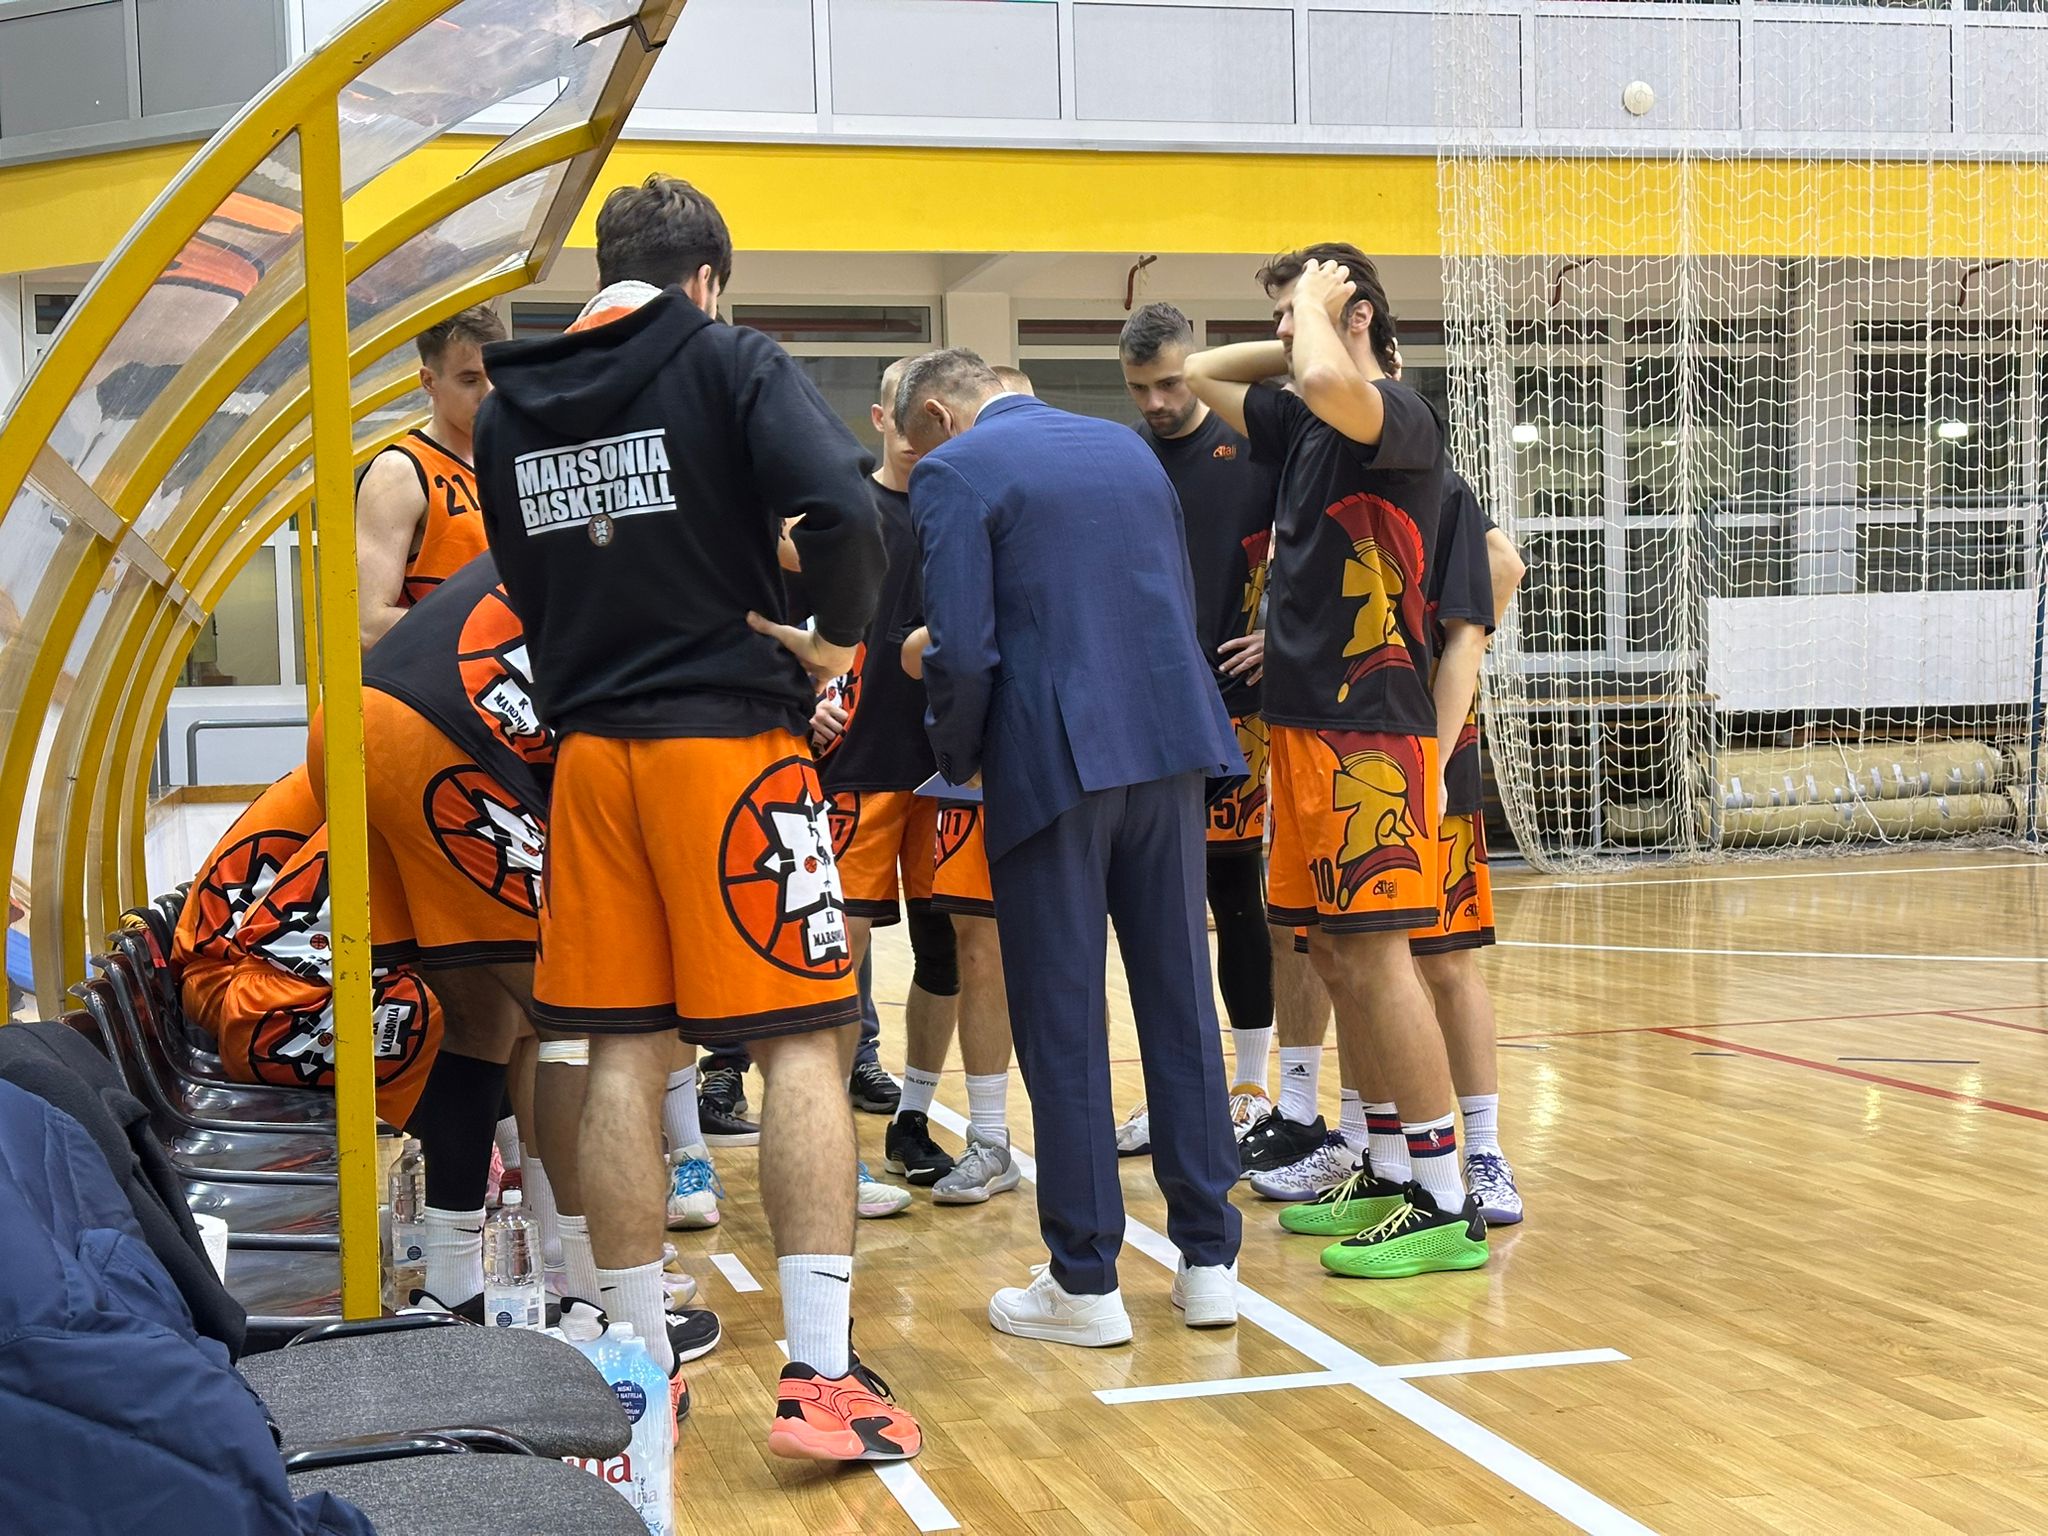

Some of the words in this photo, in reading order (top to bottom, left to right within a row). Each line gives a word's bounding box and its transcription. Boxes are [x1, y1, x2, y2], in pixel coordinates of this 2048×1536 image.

[515, 437, 671, 498] MARSONIA
[434, 474, 480, 517] 21
[519, 473, 675, 528] BASKETBALL
[944, 810, 962, 837] 11
[1308, 857, 1336, 904] 10
[380, 1007, 400, 1053] MARSONIA
